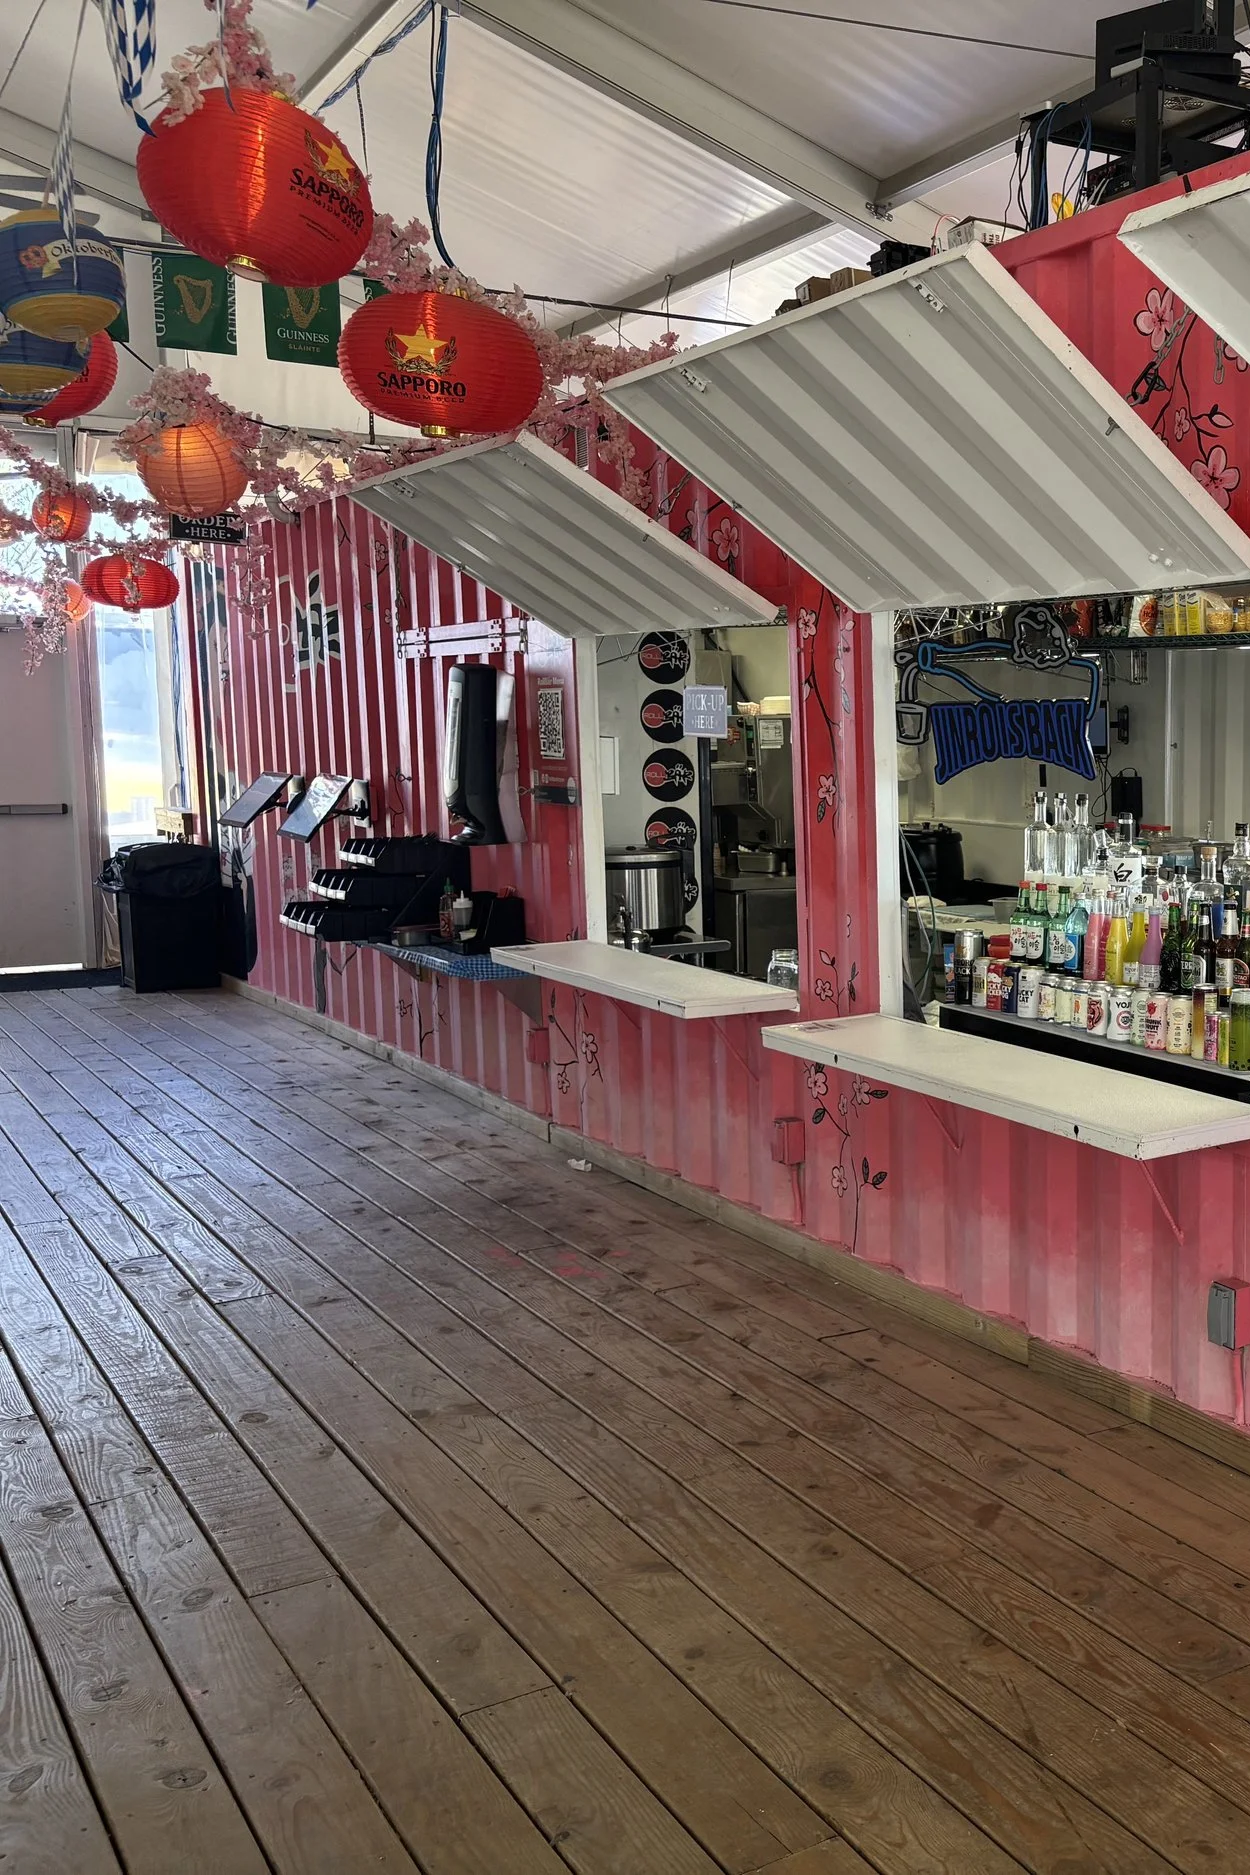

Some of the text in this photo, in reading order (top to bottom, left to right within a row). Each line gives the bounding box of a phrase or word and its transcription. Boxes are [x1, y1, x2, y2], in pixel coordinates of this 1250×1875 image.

[290, 168, 364, 228] SAPPORO
[152, 256, 166, 337] GUINNESS
[277, 327, 330, 344] GUINNESS
[377, 371, 467, 397] SAPPORO
[190, 527, 227, 539] HERE
[686, 694, 725, 711] PICK-UP
[694, 715, 715, 729] HERE
